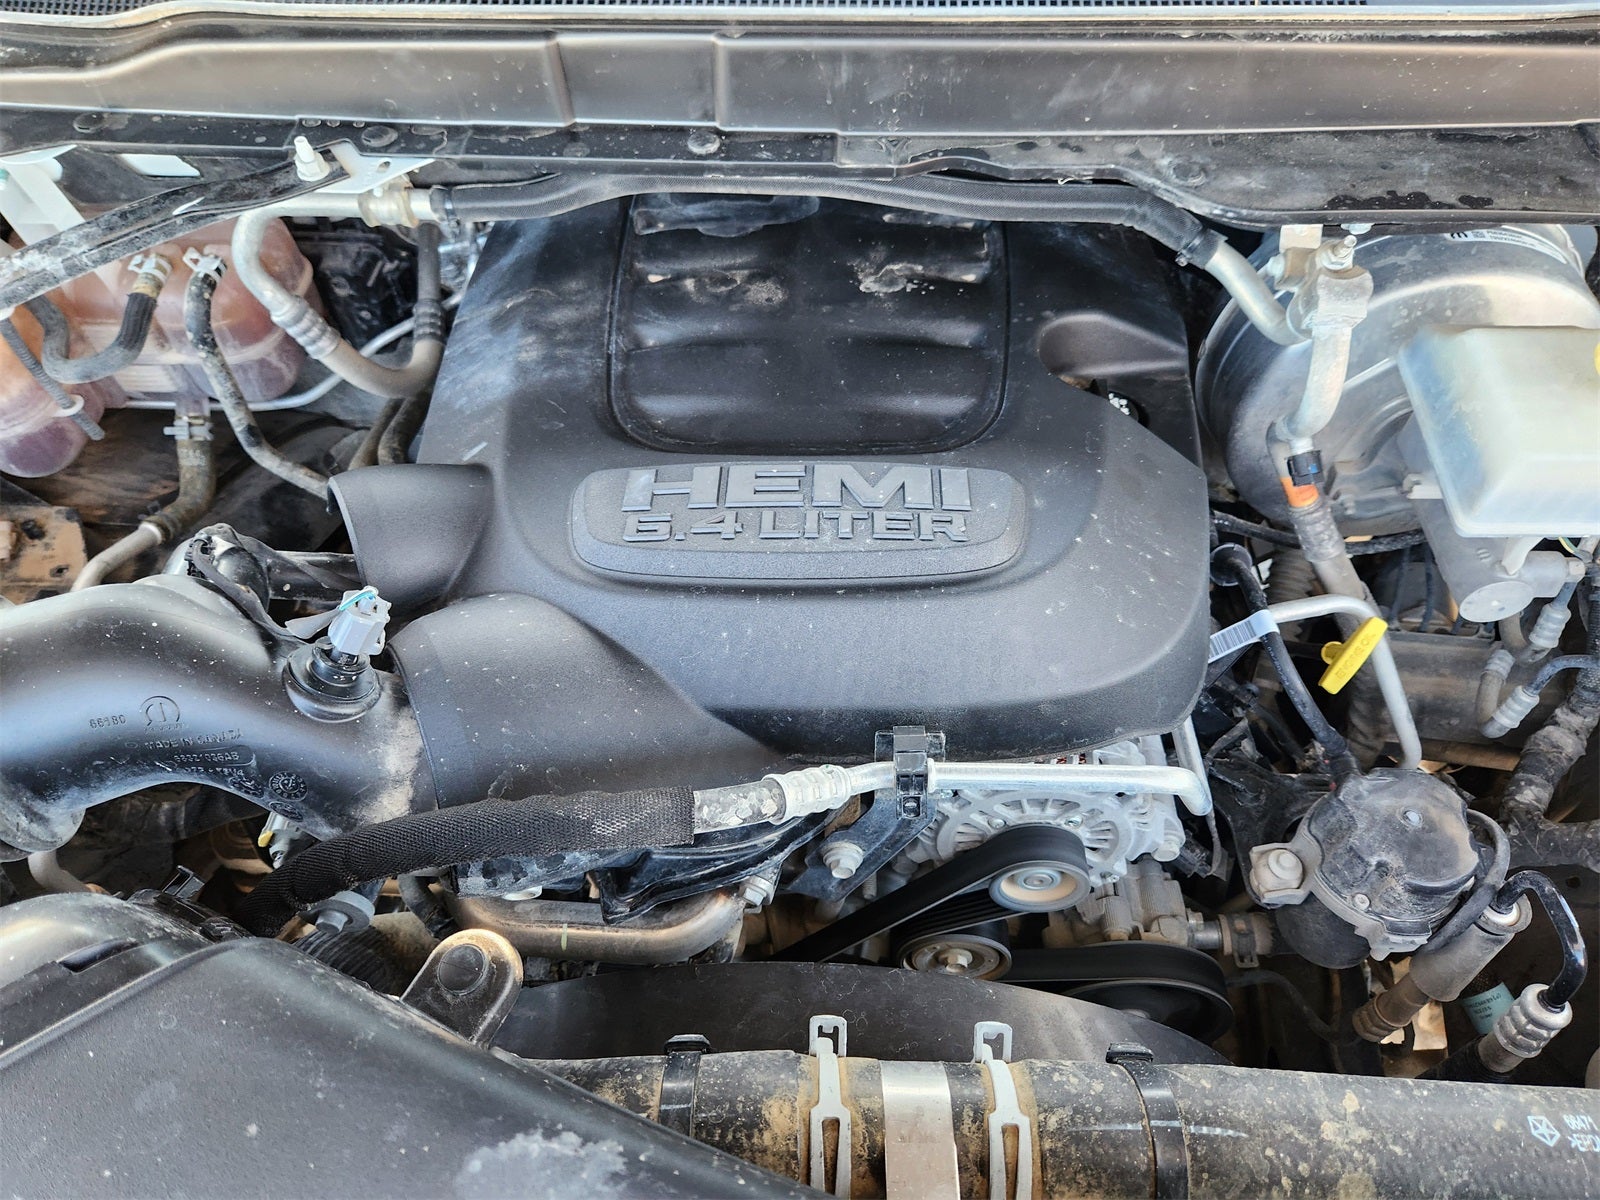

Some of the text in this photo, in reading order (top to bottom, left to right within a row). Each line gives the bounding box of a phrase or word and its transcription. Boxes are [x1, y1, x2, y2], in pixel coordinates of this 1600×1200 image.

[621, 464, 972, 511] HEMI
[622, 510, 971, 542] 6.4 LITER
[144, 739, 180, 750] MADE
[181, 737, 194, 748] IN
